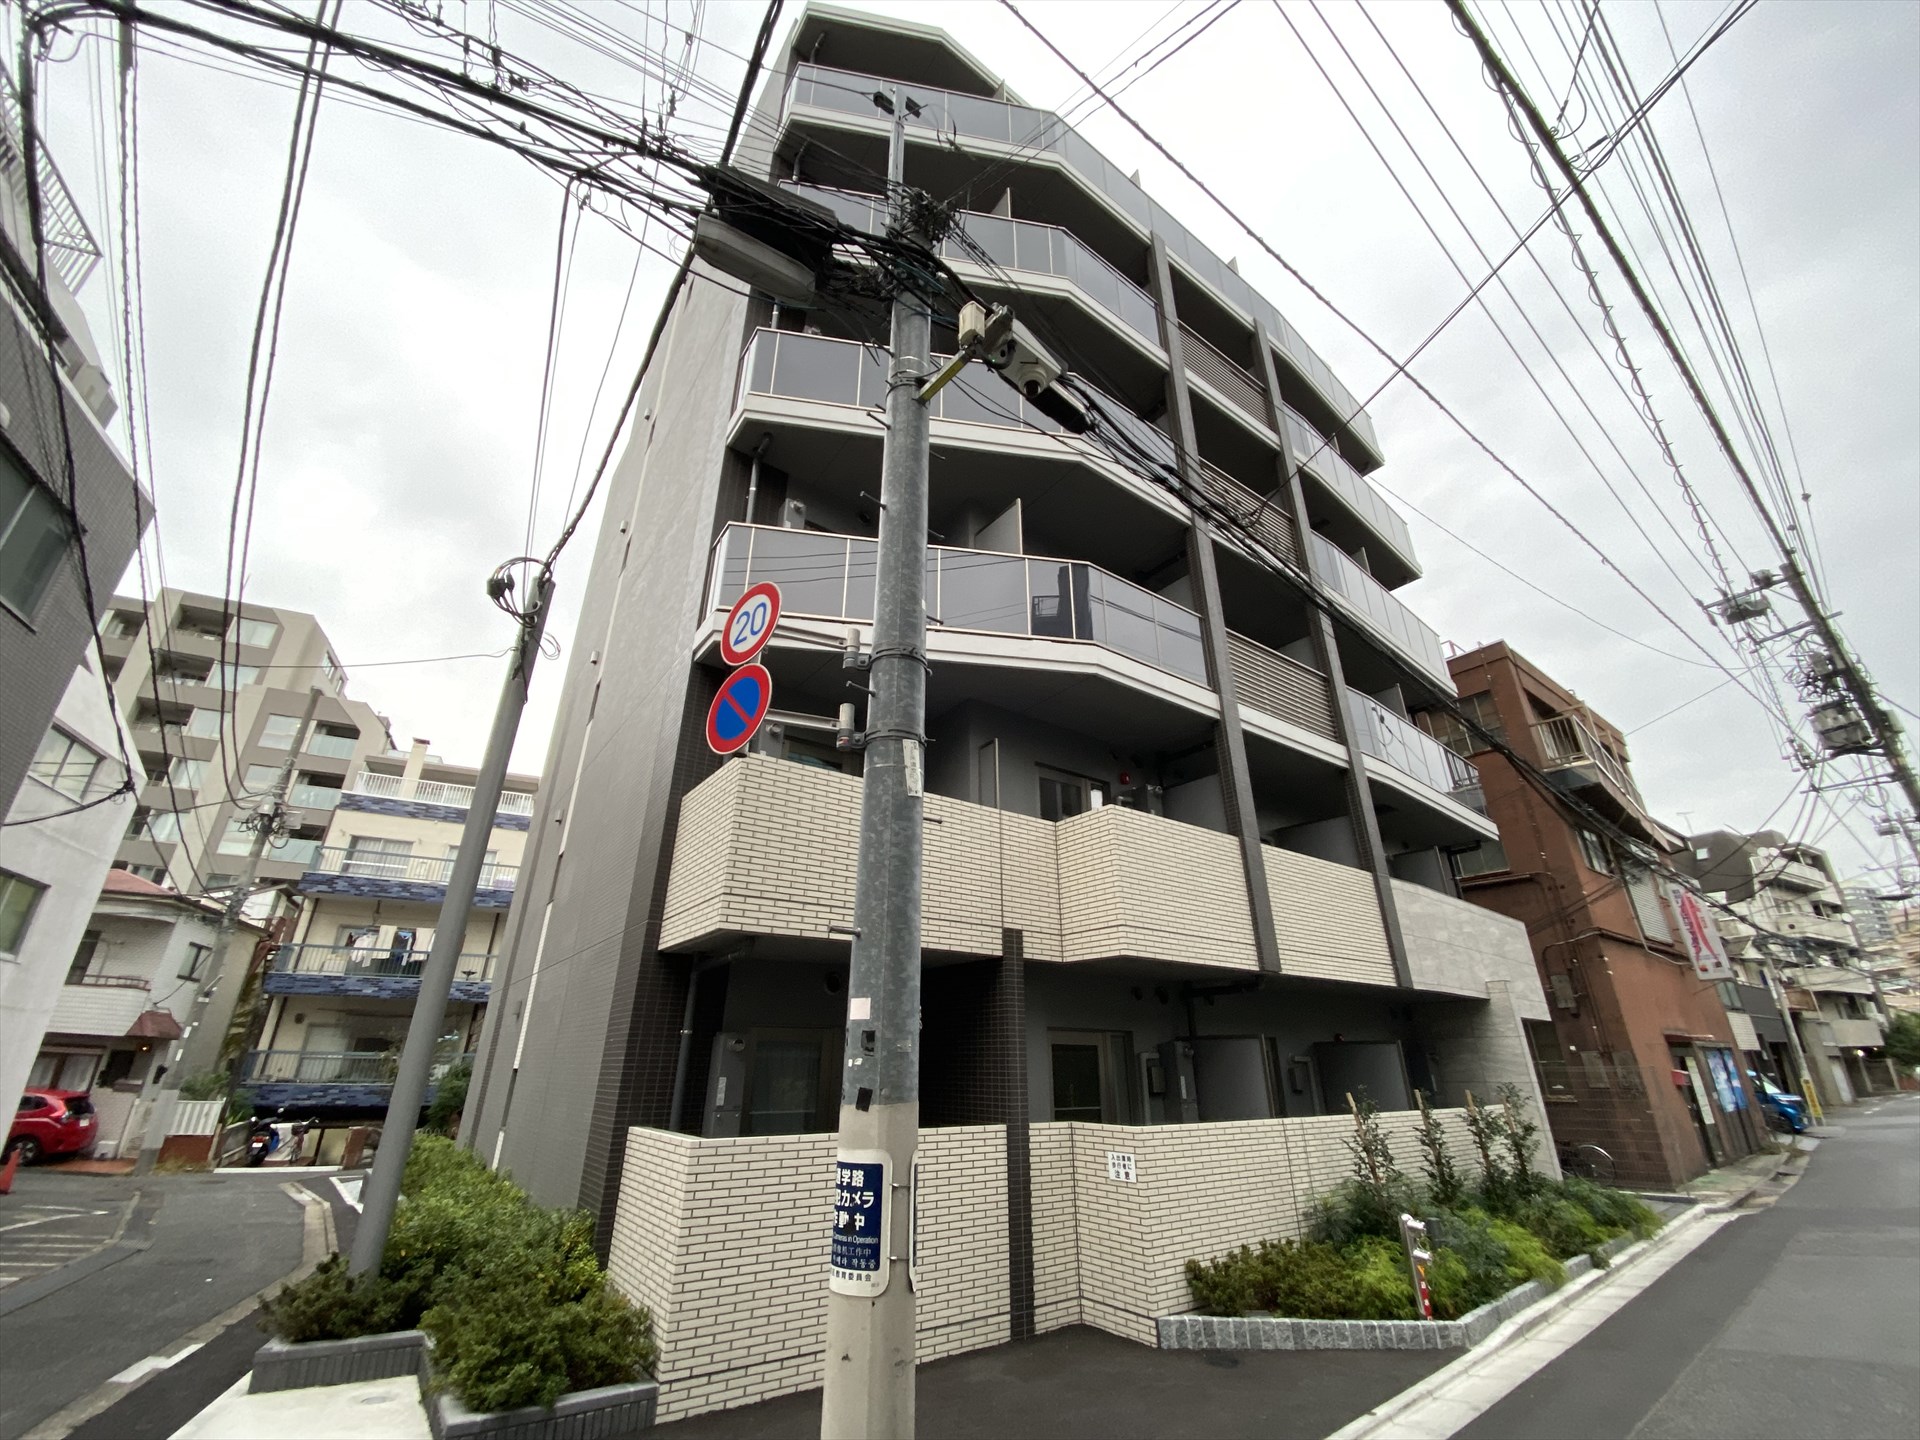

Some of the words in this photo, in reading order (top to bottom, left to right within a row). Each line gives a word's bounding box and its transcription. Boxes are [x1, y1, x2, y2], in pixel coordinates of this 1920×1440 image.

[733, 602, 767, 647] 20
[1115, 1170, 1130, 1180] 注意
[852, 1235, 879, 1245] Operation
